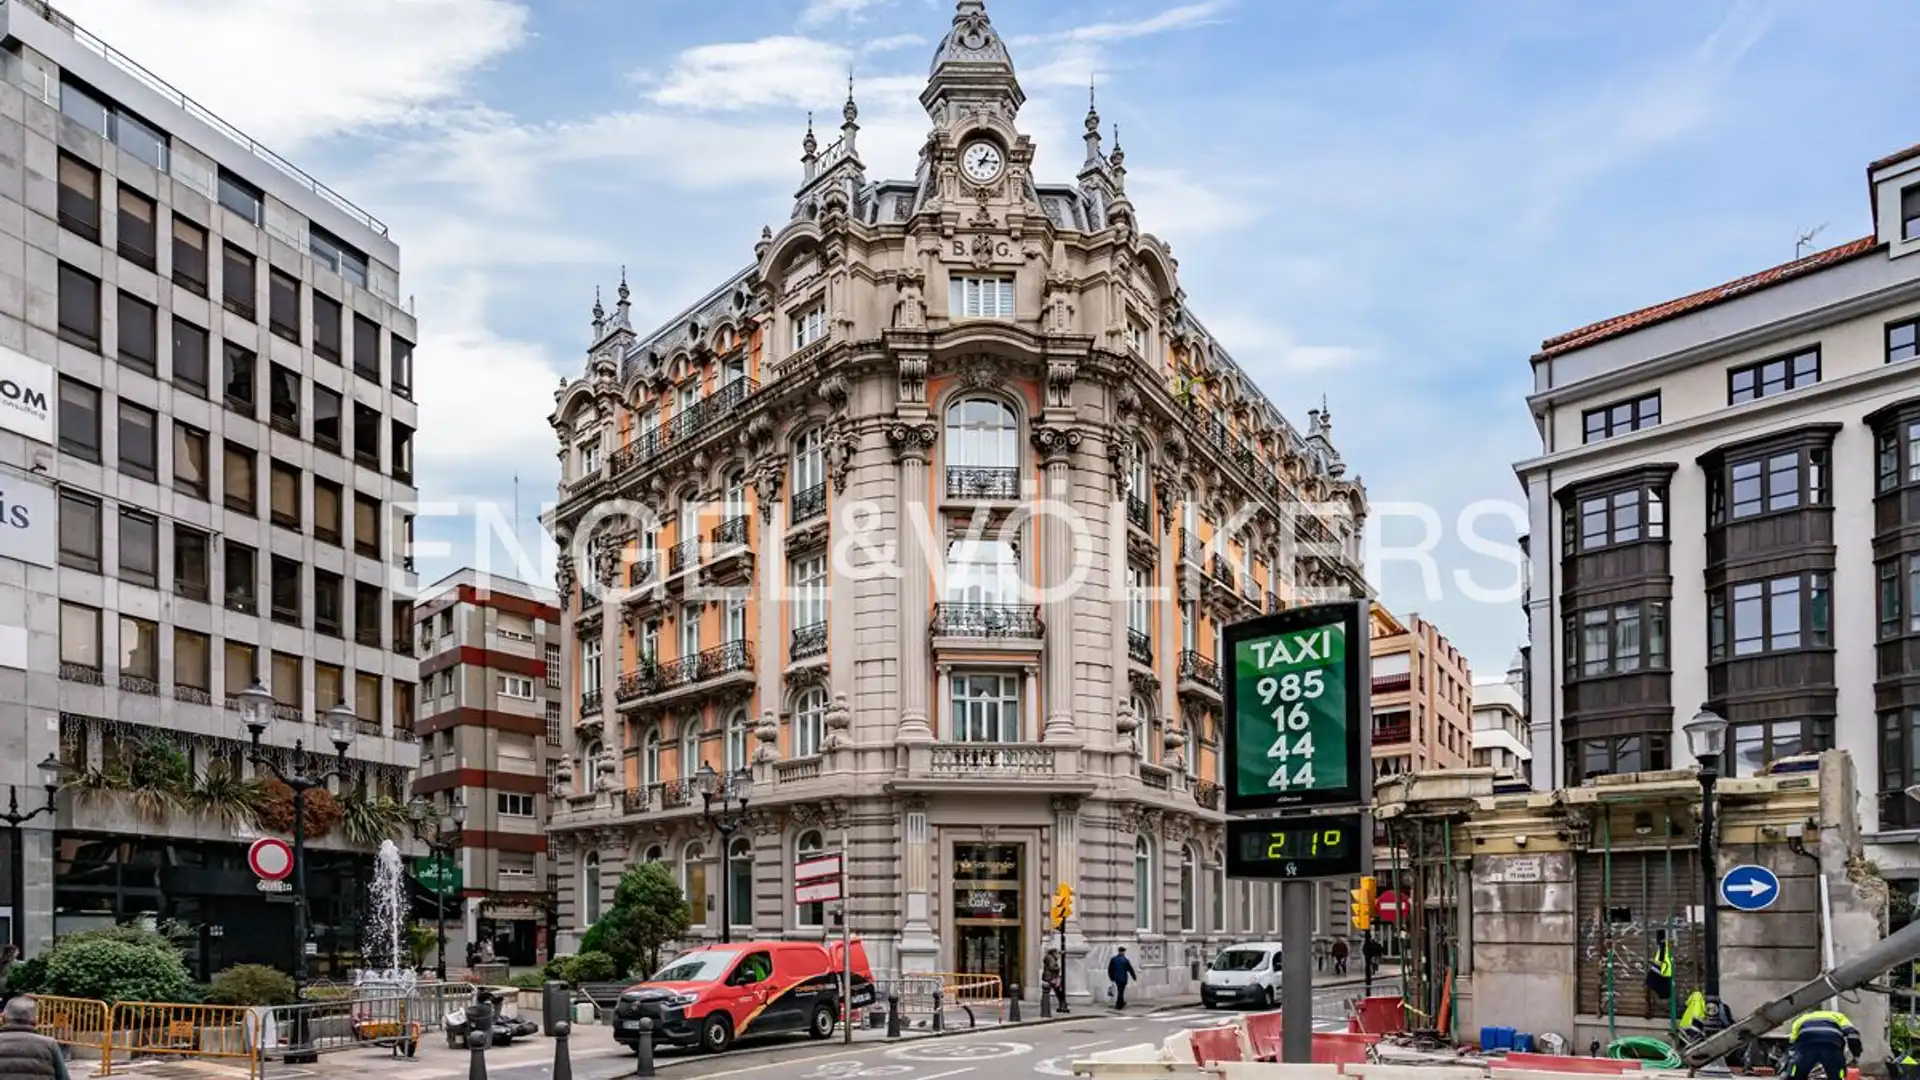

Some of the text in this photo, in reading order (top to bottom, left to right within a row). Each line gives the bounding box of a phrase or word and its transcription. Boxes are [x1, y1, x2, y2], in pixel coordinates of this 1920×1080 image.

[1251, 631, 1331, 669] TAXI
[1257, 669, 1325, 705] 985
[1271, 702, 1310, 732] 16
[1267, 731, 1315, 762] 44
[1267, 762, 1316, 791] 44
